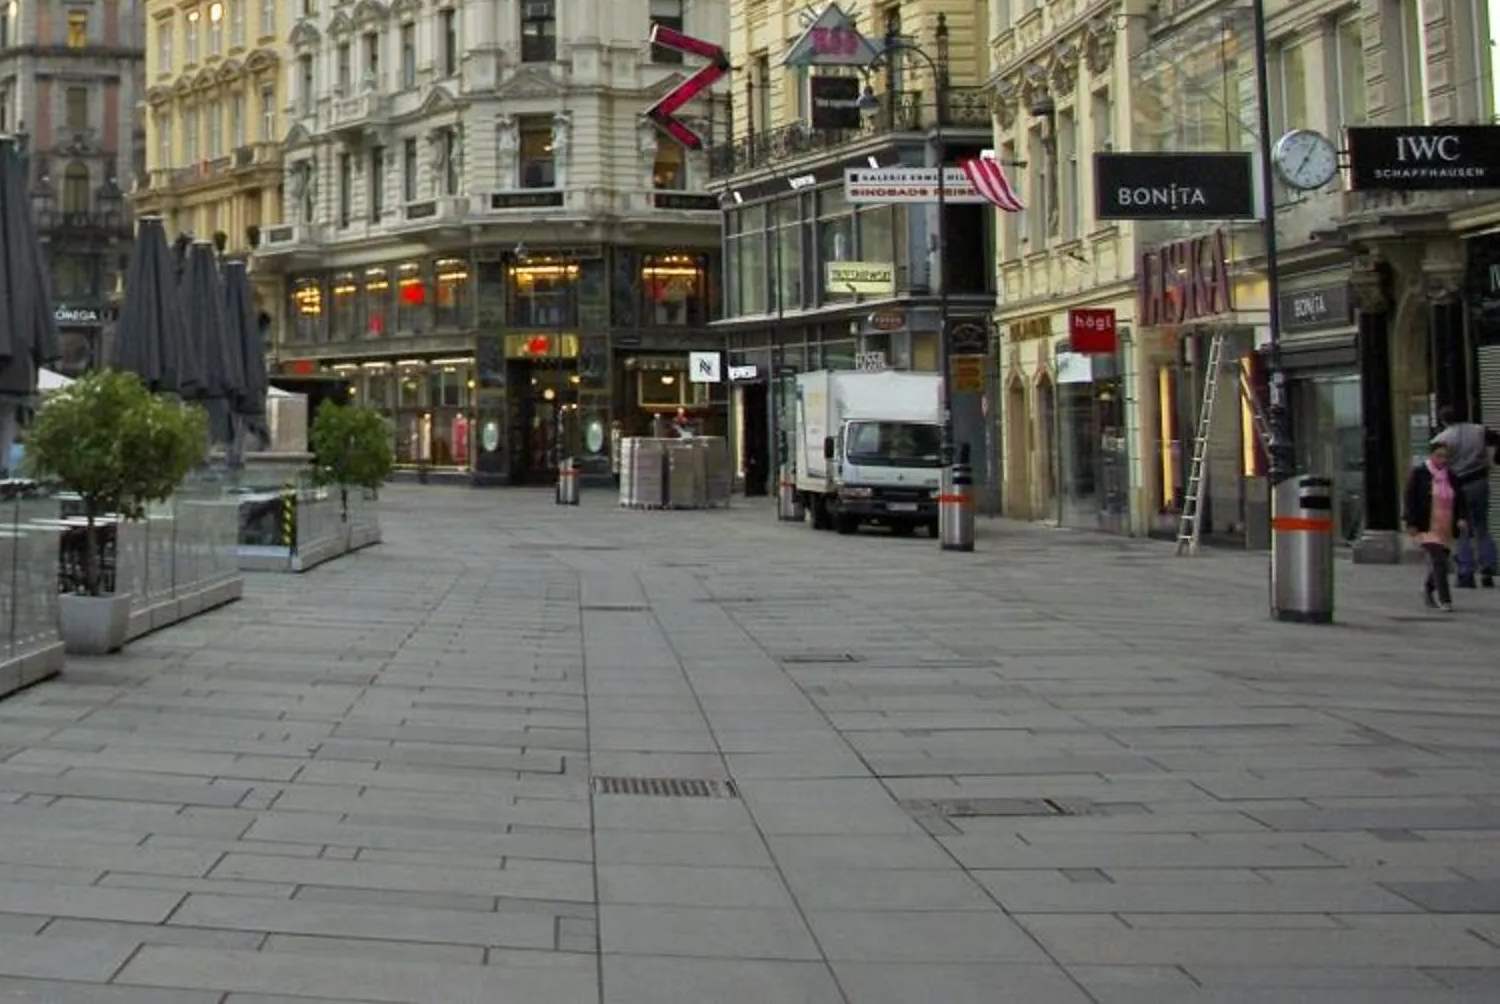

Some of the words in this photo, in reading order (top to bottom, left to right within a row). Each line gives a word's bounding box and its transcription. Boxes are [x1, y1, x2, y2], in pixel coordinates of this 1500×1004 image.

[1396, 135, 1460, 161] IWC
[1374, 168, 1485, 179] SCHAFFHAUSEN
[1118, 183, 1206, 209] BONITA
[1075, 315, 1113, 331] högl
